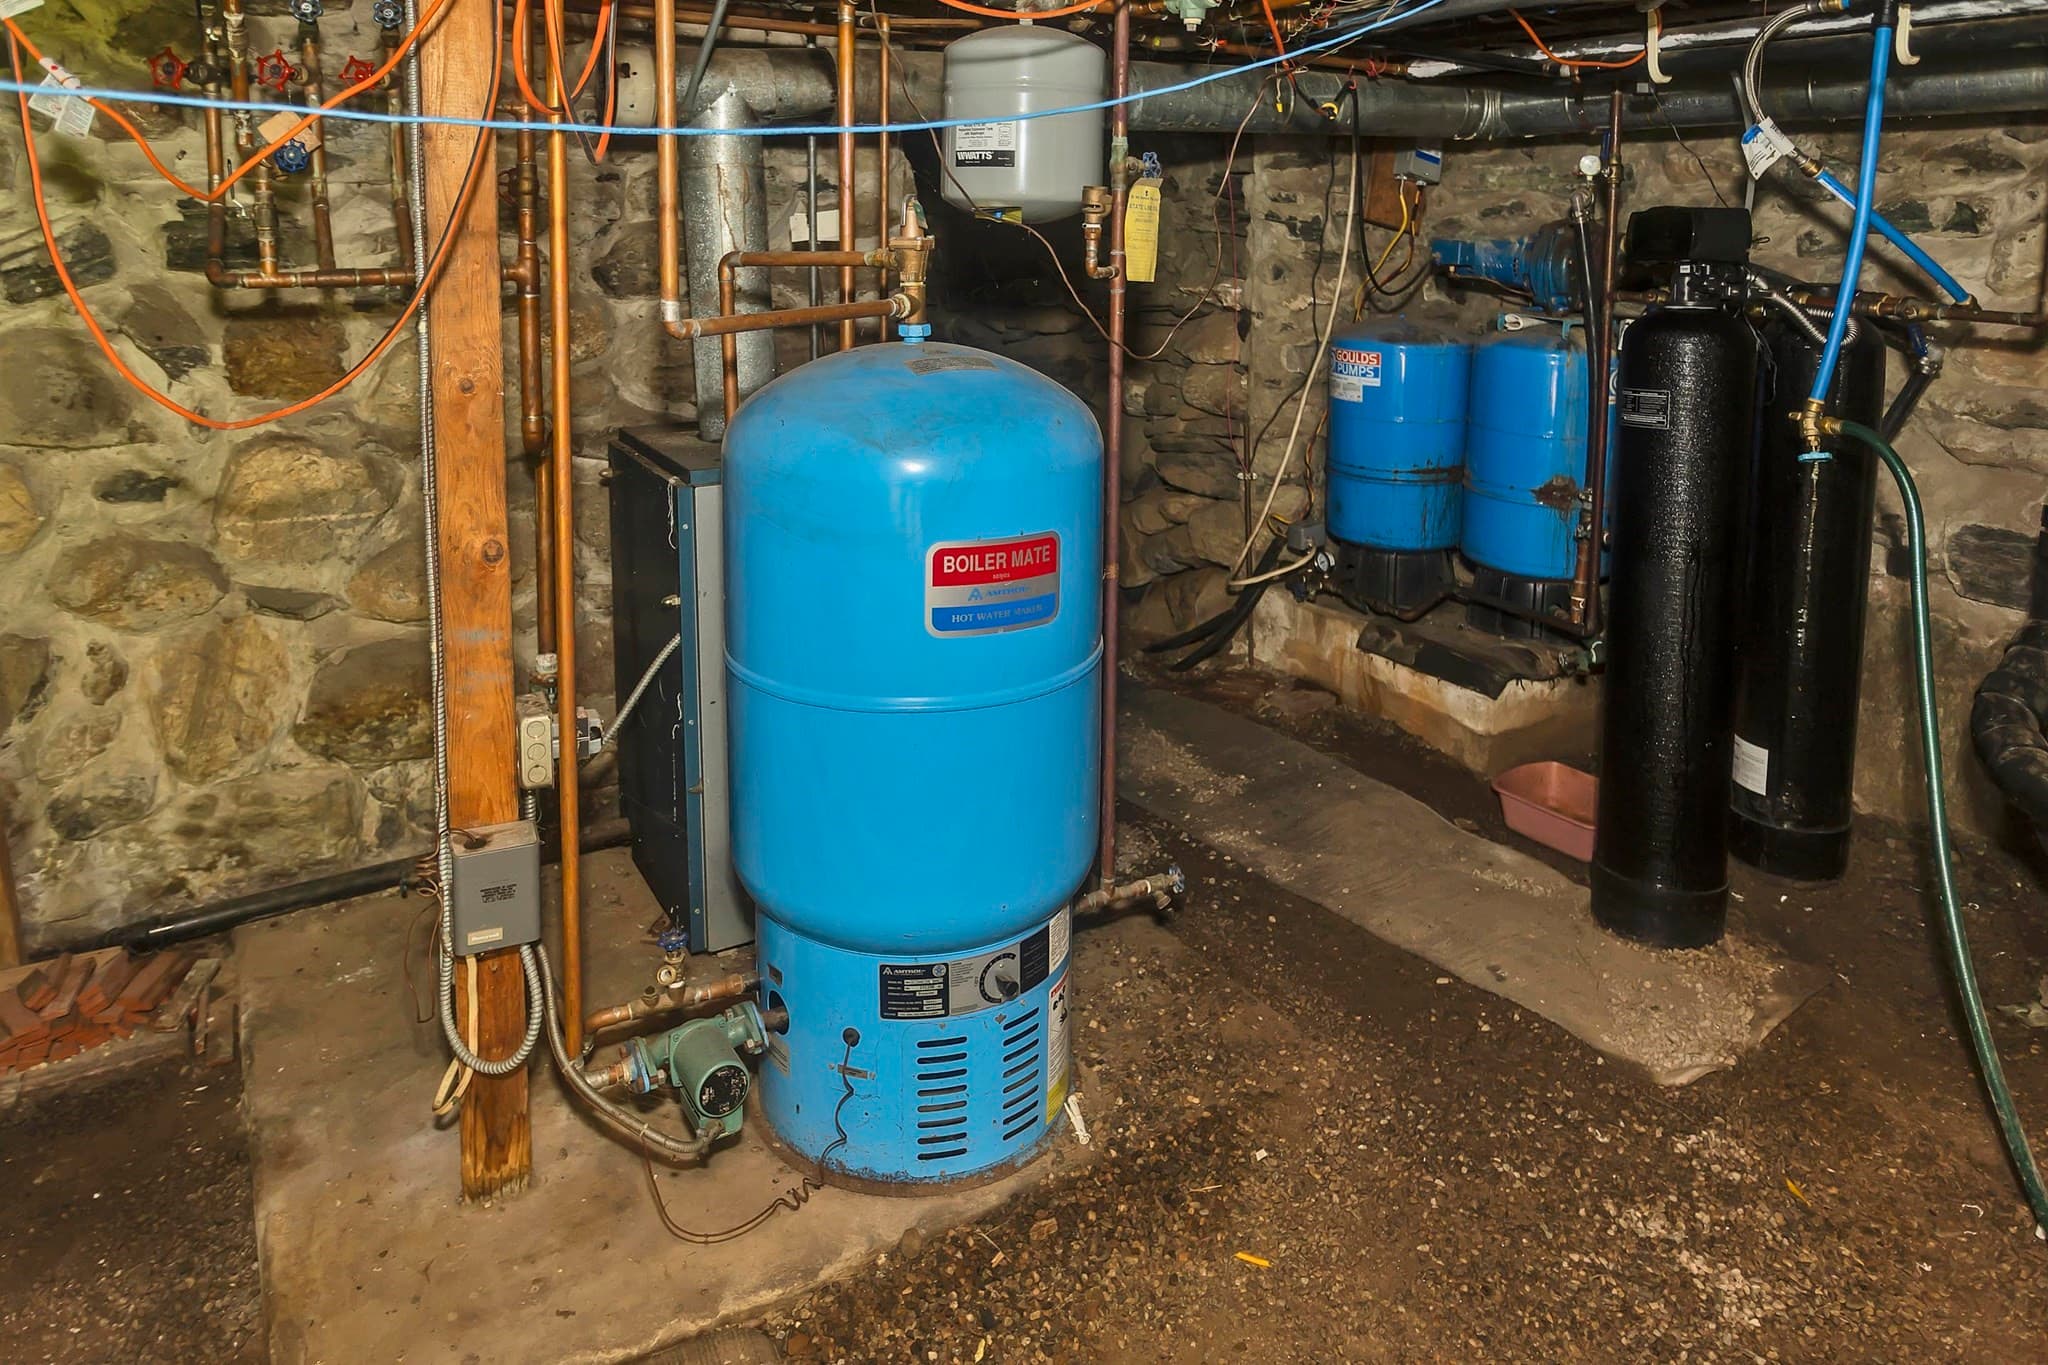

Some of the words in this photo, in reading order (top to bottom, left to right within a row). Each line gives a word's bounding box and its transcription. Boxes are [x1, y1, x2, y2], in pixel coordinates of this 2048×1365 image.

[957, 151, 993, 161] WATTS
[1336, 350, 1377, 365] GOULDS
[1337, 362, 1375, 378] PUMPS
[943, 552, 1007, 573] BOILER
[1011, 545, 1050, 567] MATE
[952, 613, 974, 623] HOT
[977, 609, 1011, 621] WATER
